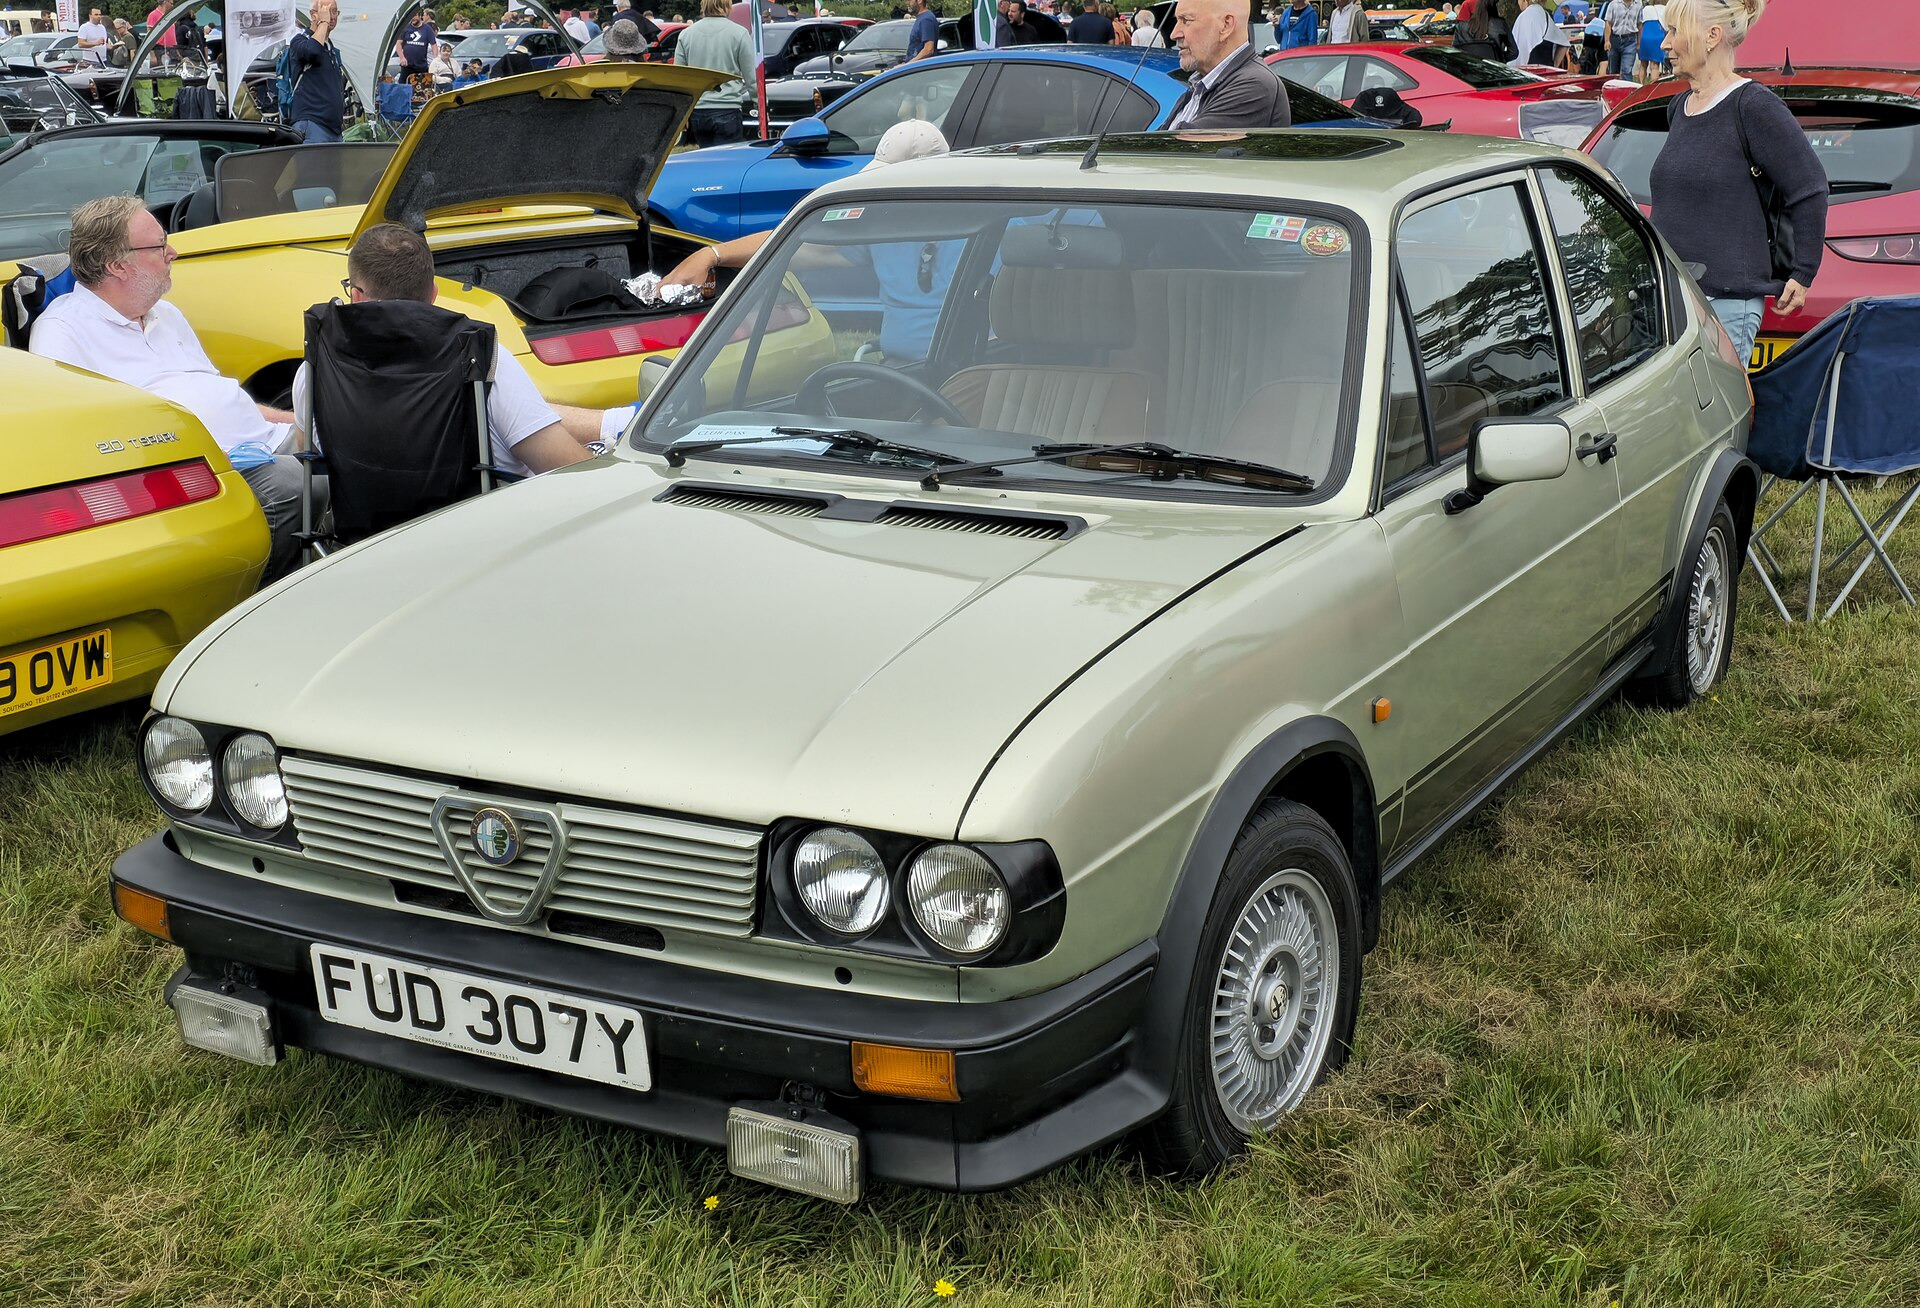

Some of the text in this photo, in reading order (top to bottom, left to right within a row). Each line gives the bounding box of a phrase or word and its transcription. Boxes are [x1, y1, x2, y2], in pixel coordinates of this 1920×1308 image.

[29, 634, 105, 696] OVW
[2, 700, 34, 714] SOUTHEND
[35, 697, 46, 705] TEL
[319, 953, 635, 1075] FUD 307Y
[414, 1034, 452, 1047] CORNERHOUSE
[453, 1043, 474, 1052] GARAGE
[476, 1048, 497, 1057] OXFORD
